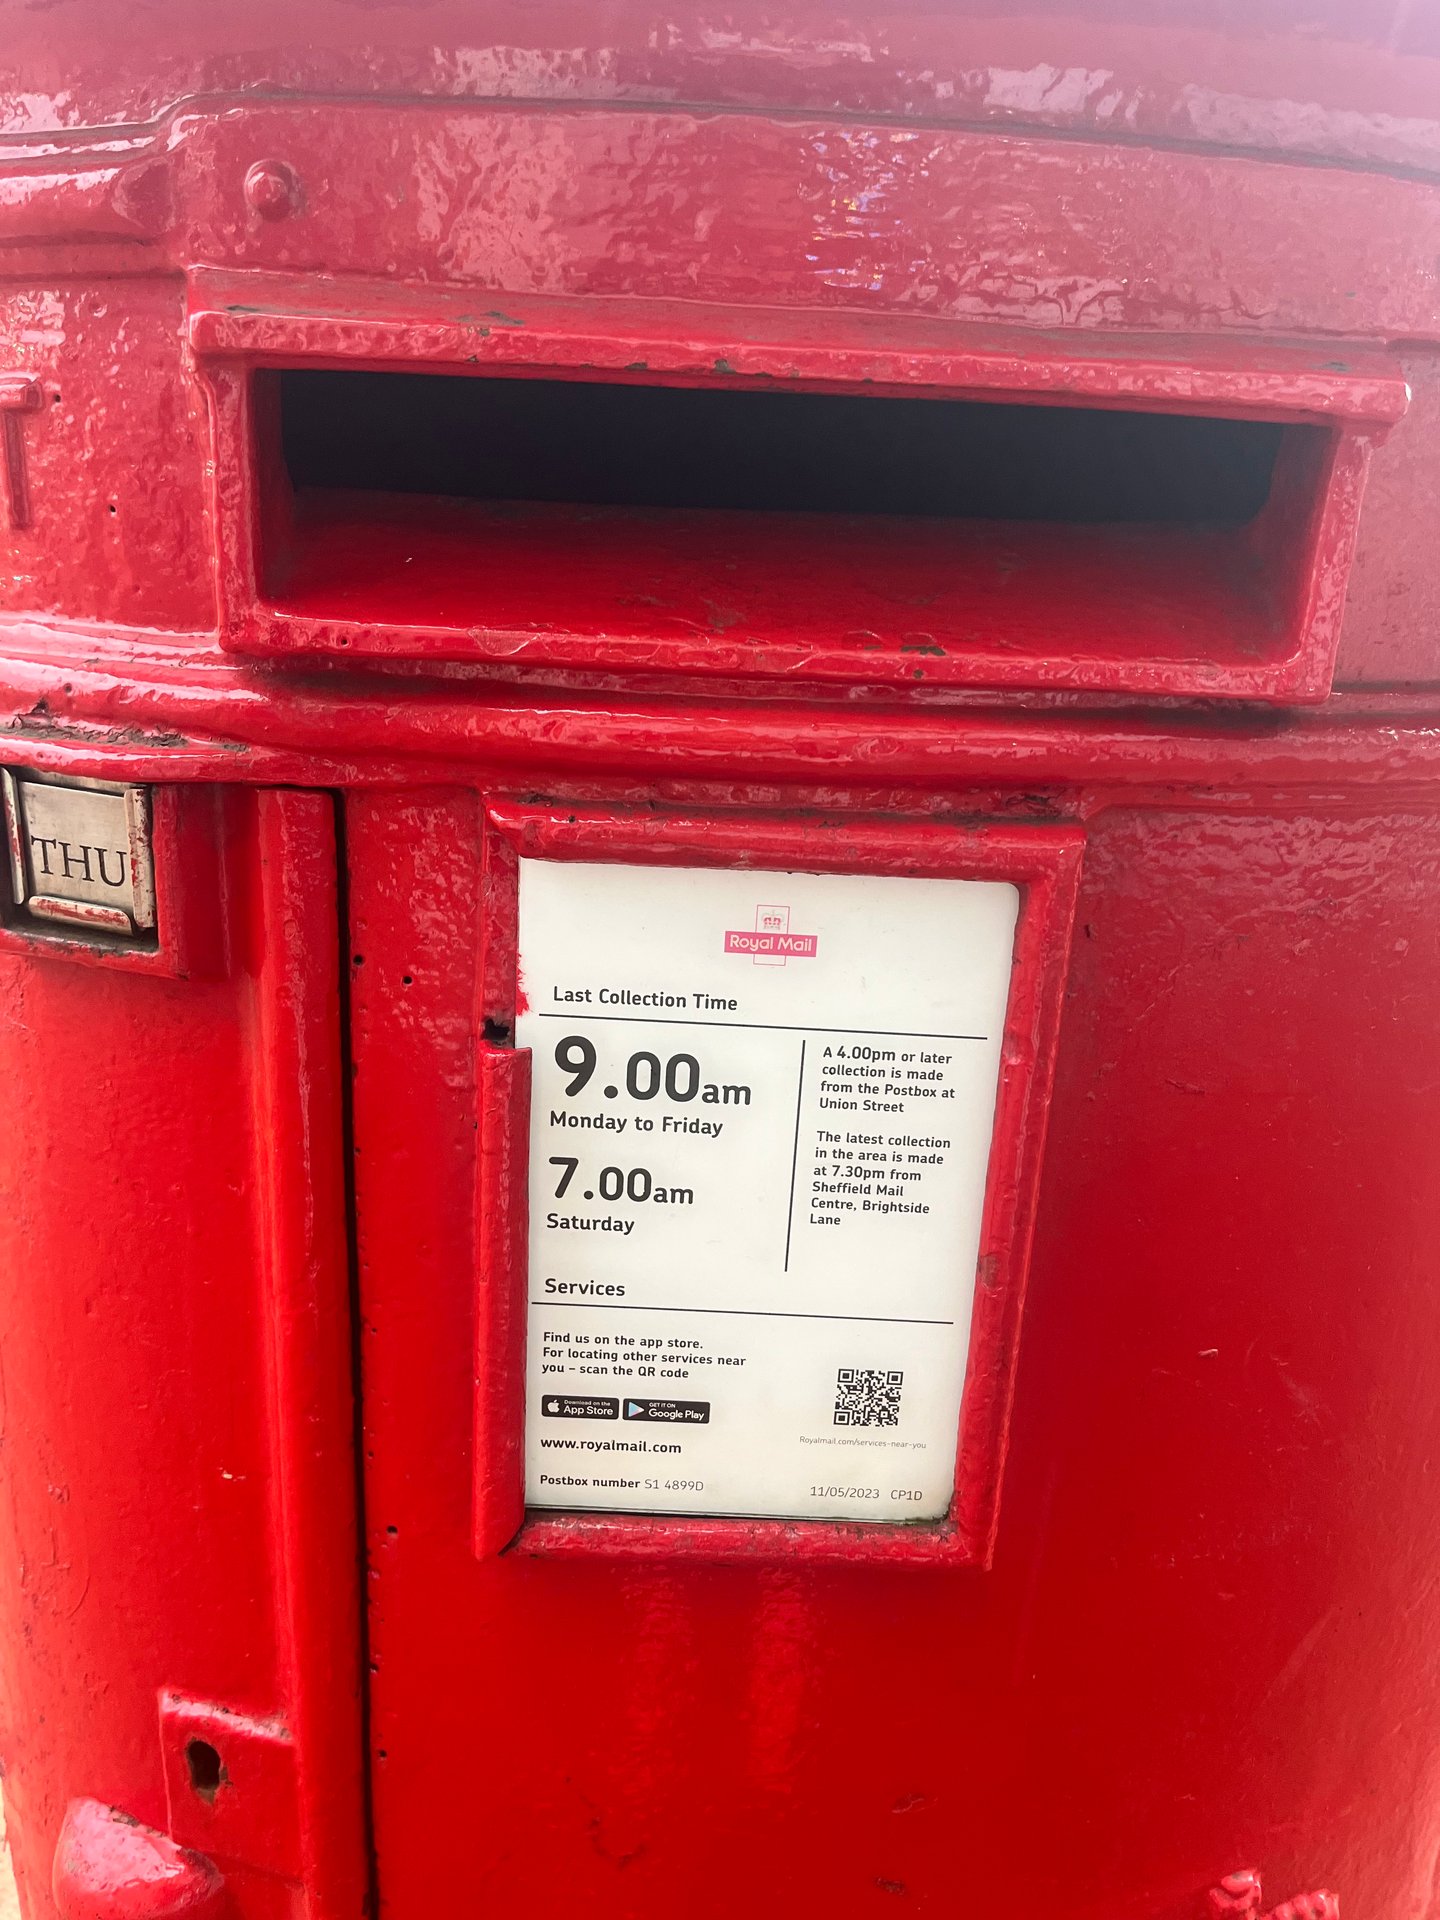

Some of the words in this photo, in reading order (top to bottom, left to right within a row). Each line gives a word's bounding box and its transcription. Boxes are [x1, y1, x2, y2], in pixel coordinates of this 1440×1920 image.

[31, 835, 127, 887] THU
[729, 934, 774, 952] Royal
[777, 937, 813, 952] Mail
[553, 985, 593, 1003] Last
[598, 988, 687, 1008] Collection
[692, 993, 738, 1011] Time
[822, 1046, 833, 1058] A
[836, 1045, 896, 1063] 4.00pm
[901, 1053, 916, 1063] or
[920, 1051, 953, 1065] later
[555, 1036, 751, 1105] 9.00am
[822, 1064, 886, 1078] collection
[890, 1066, 902, 1079] is
[906, 1069, 944, 1081] made
[820, 1080, 853, 1093] from
[857, 1082, 880, 1095] the
[884, 1083, 937, 1098] Postbox
[941, 1088, 956, 1099] at
[819, 1097, 858, 1111] Union
[862, 1099, 905, 1113] Street
[551, 1111, 627, 1133] Monday
[634, 1116, 654, 1132] to
[663, 1117, 723, 1138] Friday
[816, 1130, 841, 1143] The
[846, 1132, 884, 1145] latest
[888, 1135, 951, 1149] collection
[815, 1146, 827, 1159] in
[831, 1148, 854, 1160] the
[857, 1151, 887, 1162] area
[892, 1150, 903, 1163] is
[907, 1153, 944, 1165] made
[549, 1157, 693, 1204] 7.00am
[813, 1166, 827, 1176] at
[832, 1164, 885, 1183] 7.30pm
[889, 1168, 922, 1181] from
[812, 1180, 872, 1195] Sheffield
[876, 1184, 904, 1197] Mail
[811, 1197, 857, 1212] Centre,
[862, 1199, 930, 1214] Brightside
[547, 1213, 634, 1235] Saturday
[809, 1213, 841, 1226] Lane
[544, 1277, 626, 1297] Services
[543, 1331, 571, 1343] Find
[575, 1335, 590, 1344] us
[594, 1336, 610, 1345] on
[614, 1335, 635, 1346] the
[639, 1338, 663, 1349] app
[667, 1338, 703, 1349] store.
[543, 1346, 564, 1358] For
[567, 1348, 618, 1363] locating
[622, 1351, 658, 1362] other
[661, 1353, 713, 1365] services
[717, 1357, 747, 1366] near
[541, 1364, 565, 1375] you
[579, 1365, 608, 1375] scan
[612, 1365, 633, 1376] the
[638, 1366, 656, 1377] QR
[660, 1368, 689, 1379] code
[563, 1404, 585, 1416] App
[586, 1405, 614, 1416] Store
[648, 1408, 684, 1421] Google
[684, 1409, 705, 1421] Play
[540, 1439, 682, 1454] www.royalmail.com
[799, 1435, 927, 1450] Royalmail.com/services-near-you
[540, 1474, 588, 1486] Postbox
[592, 1478, 641, 1488] number
[644, 1478, 660, 1490] S1
[664, 1479, 704, 1492] 4899D
[810, 1486, 880, 1499] 11/05/2023
[890, 1489, 923, 1501] CP1D
